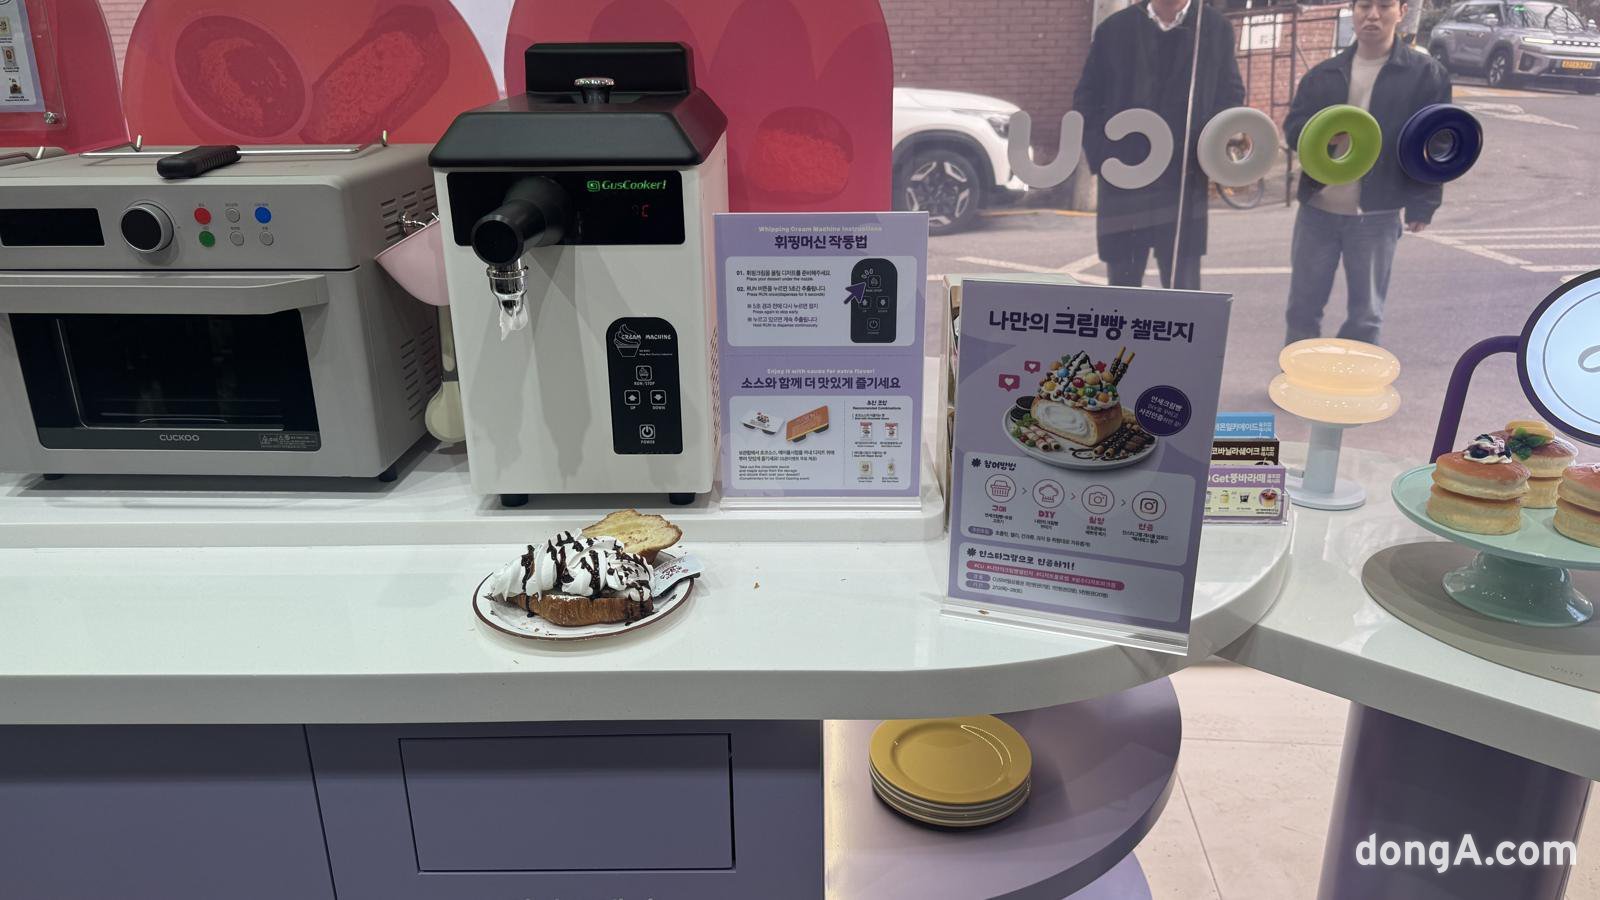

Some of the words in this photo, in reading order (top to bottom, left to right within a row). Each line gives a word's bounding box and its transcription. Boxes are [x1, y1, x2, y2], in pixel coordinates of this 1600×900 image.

[602, 179, 667, 190] GusCooker!
[774, 235, 826, 249] 휘핑머신
[828, 235, 868, 250] 작동법
[989, 310, 1049, 333] 나만의
[1052, 311, 1127, 341] 크림빵
[1130, 317, 1195, 343] 챌린지
[741, 376, 777, 389] 소스와
[778, 376, 801, 389] 함께
[804, 376, 816, 389] 더
[818, 376, 852, 389] 맛있게
[855, 376, 901, 389] 즐기세요
[159, 433, 201, 442] CUCKOO
[984, 459, 1017, 471] 참여방법
[991, 504, 1007, 512] 구매
[1038, 510, 1056, 519] DIY
[1138, 523, 1154, 532] 인증
[979, 550, 1034, 565] 인스타그램으로
[1038, 557, 1075, 571] 인증하기!
